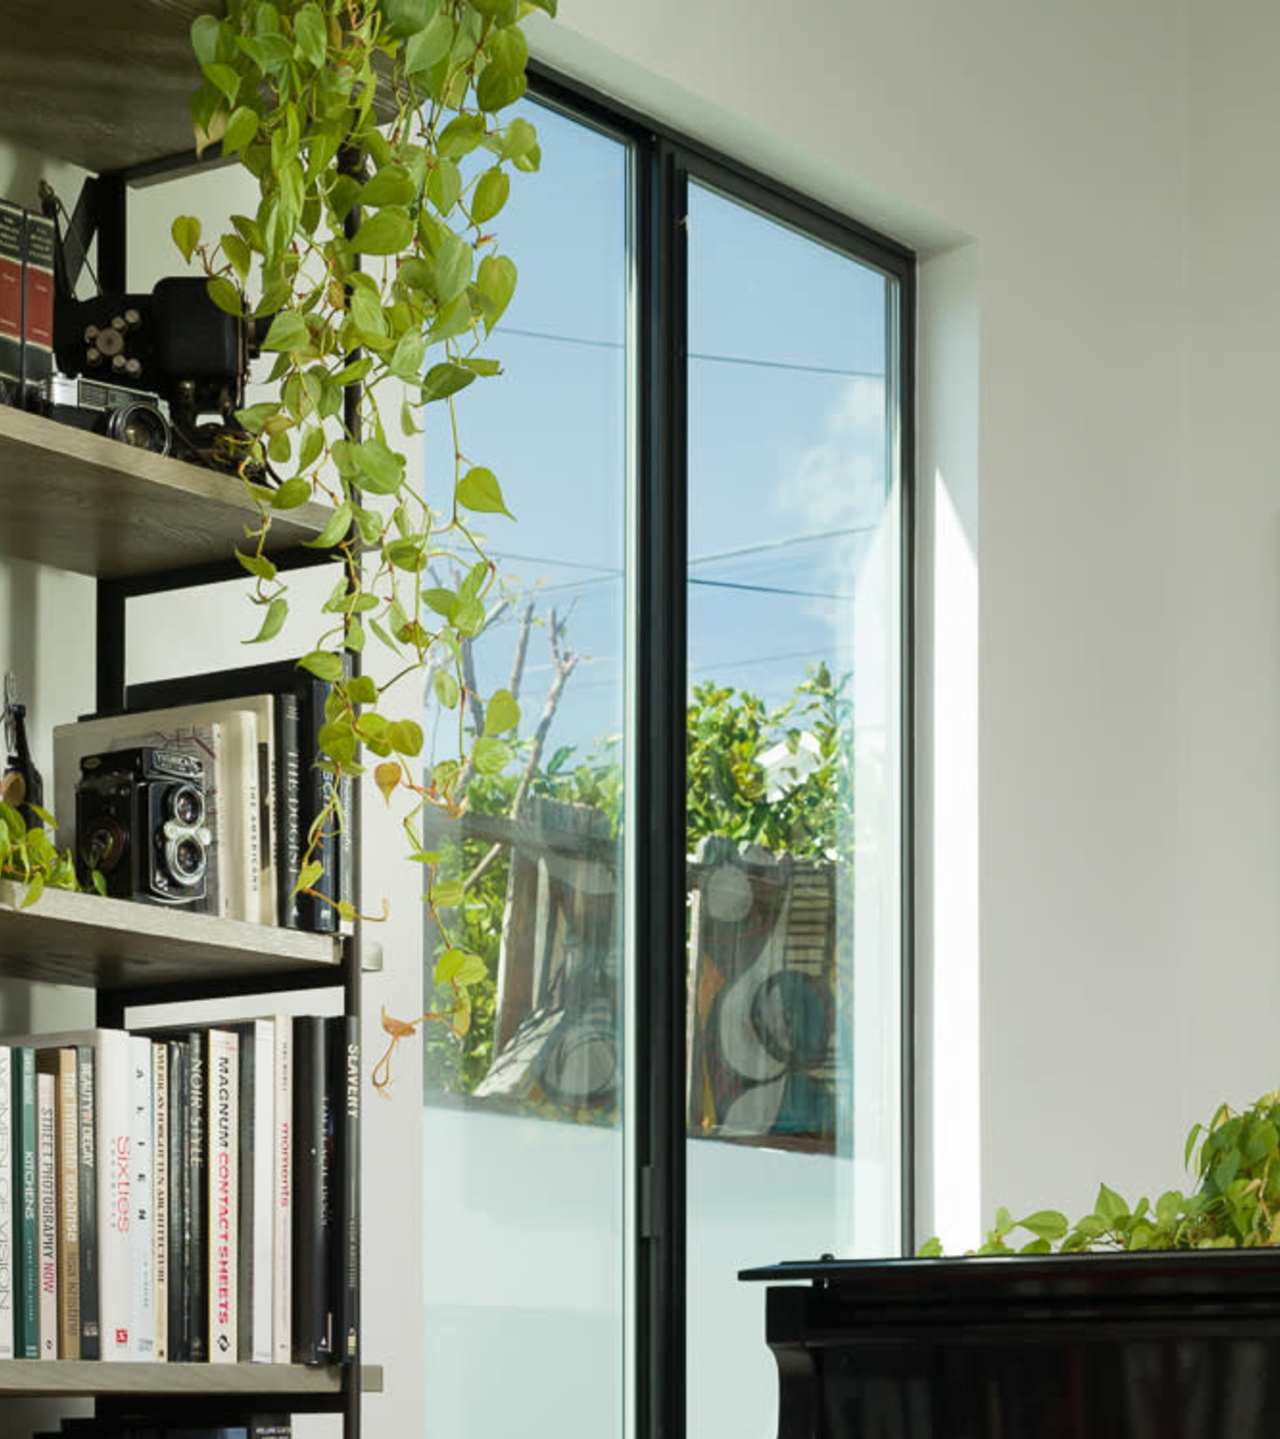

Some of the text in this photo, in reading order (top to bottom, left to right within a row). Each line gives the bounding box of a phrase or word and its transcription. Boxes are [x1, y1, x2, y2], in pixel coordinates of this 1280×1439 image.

[80, 1063, 93, 1111] BEAUTY
[189, 1058, 204, 1168] NOIR STYLE
[346, 1043, 359, 1120] SLAVERY
[23, 1151, 35, 1221] KITCHENS
[81, 1127, 94, 1168] DECAY
[42, 1107, 55, 1294] STREET PHOTOGRAPHY NOW
[218, 1057, 230, 1324] MAGNUM CONTACT SHEETS
